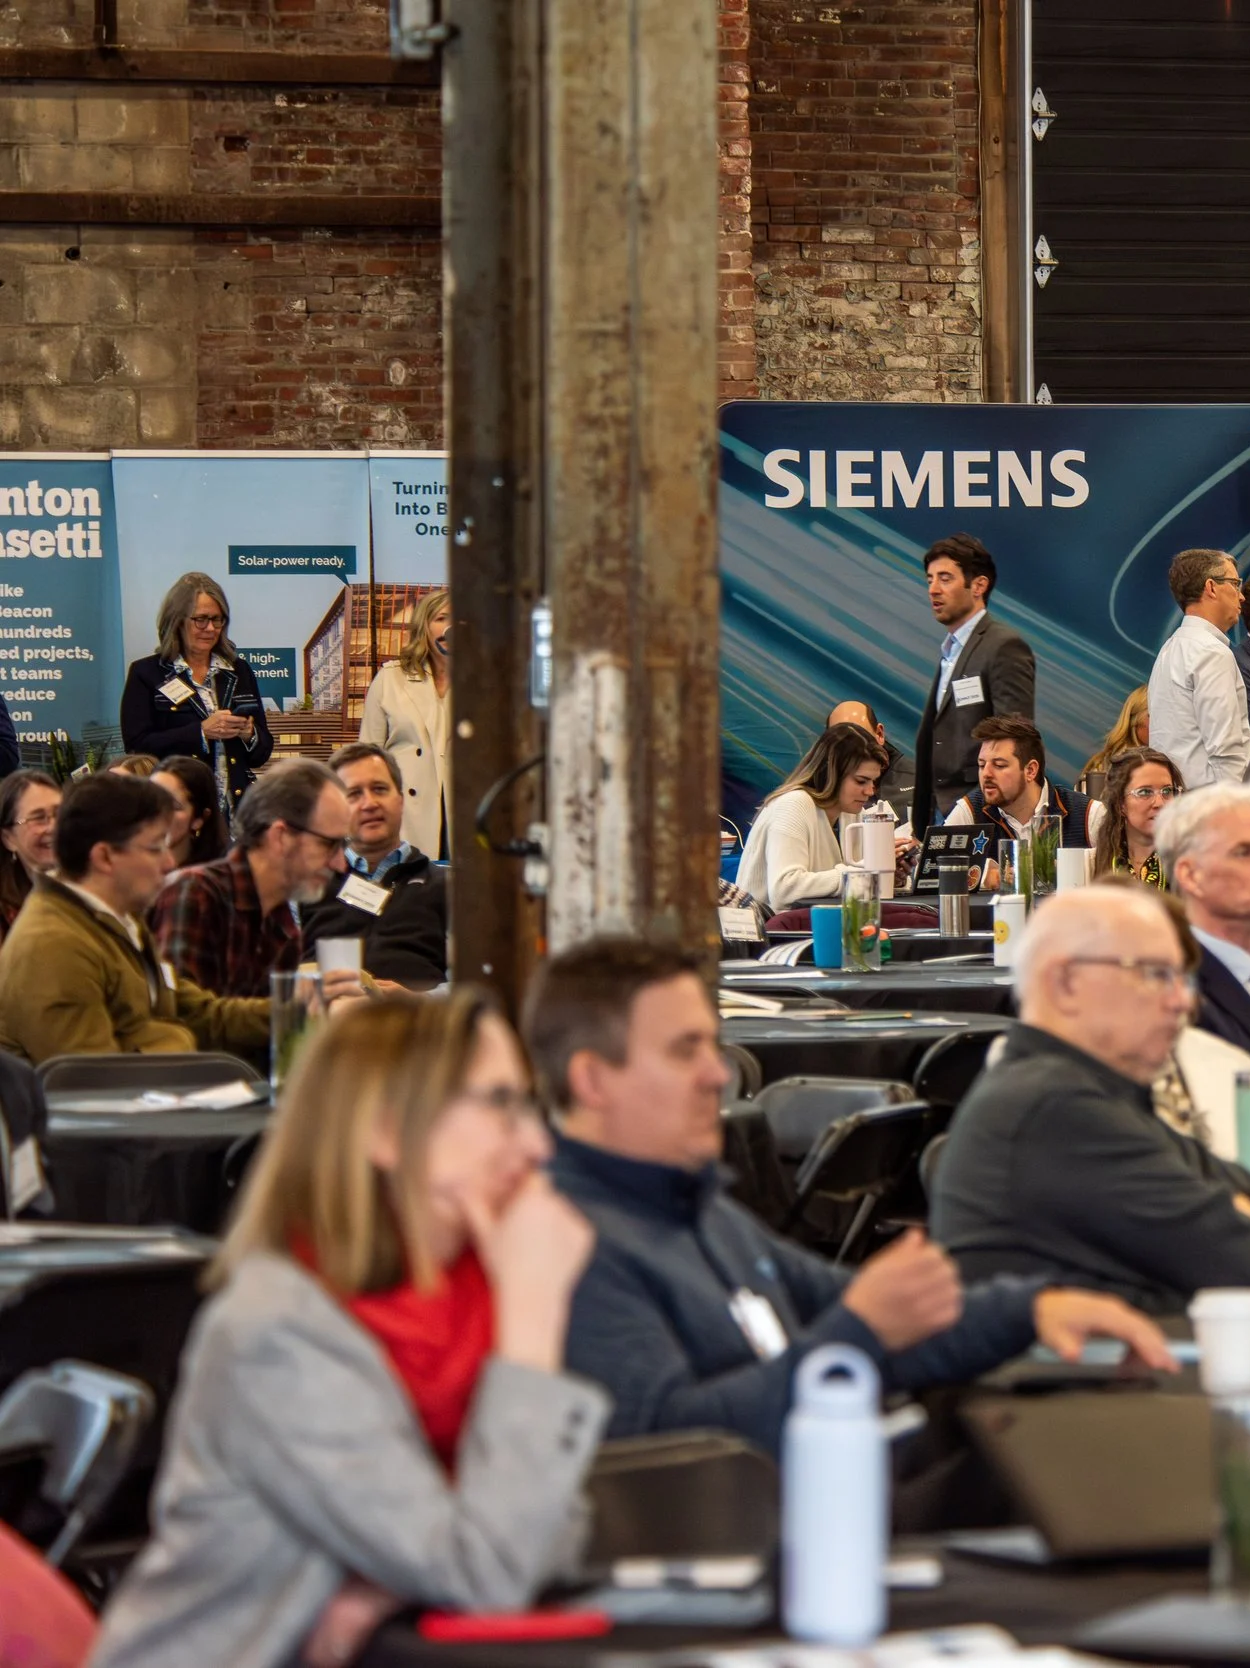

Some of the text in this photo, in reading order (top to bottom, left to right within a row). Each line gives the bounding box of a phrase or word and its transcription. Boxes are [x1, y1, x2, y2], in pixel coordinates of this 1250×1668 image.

[763, 449, 1090, 509] SIEMENS
[393, 481, 451, 495] Turnin
[395, 502, 431, 516] Into
[238, 556, 346, 568] Solar-power ready.
[23, 646, 94, 662] projects,
[249, 653, 281, 666] high-
[11, 668, 63, 680] teams
[16, 729, 68, 745] rough
